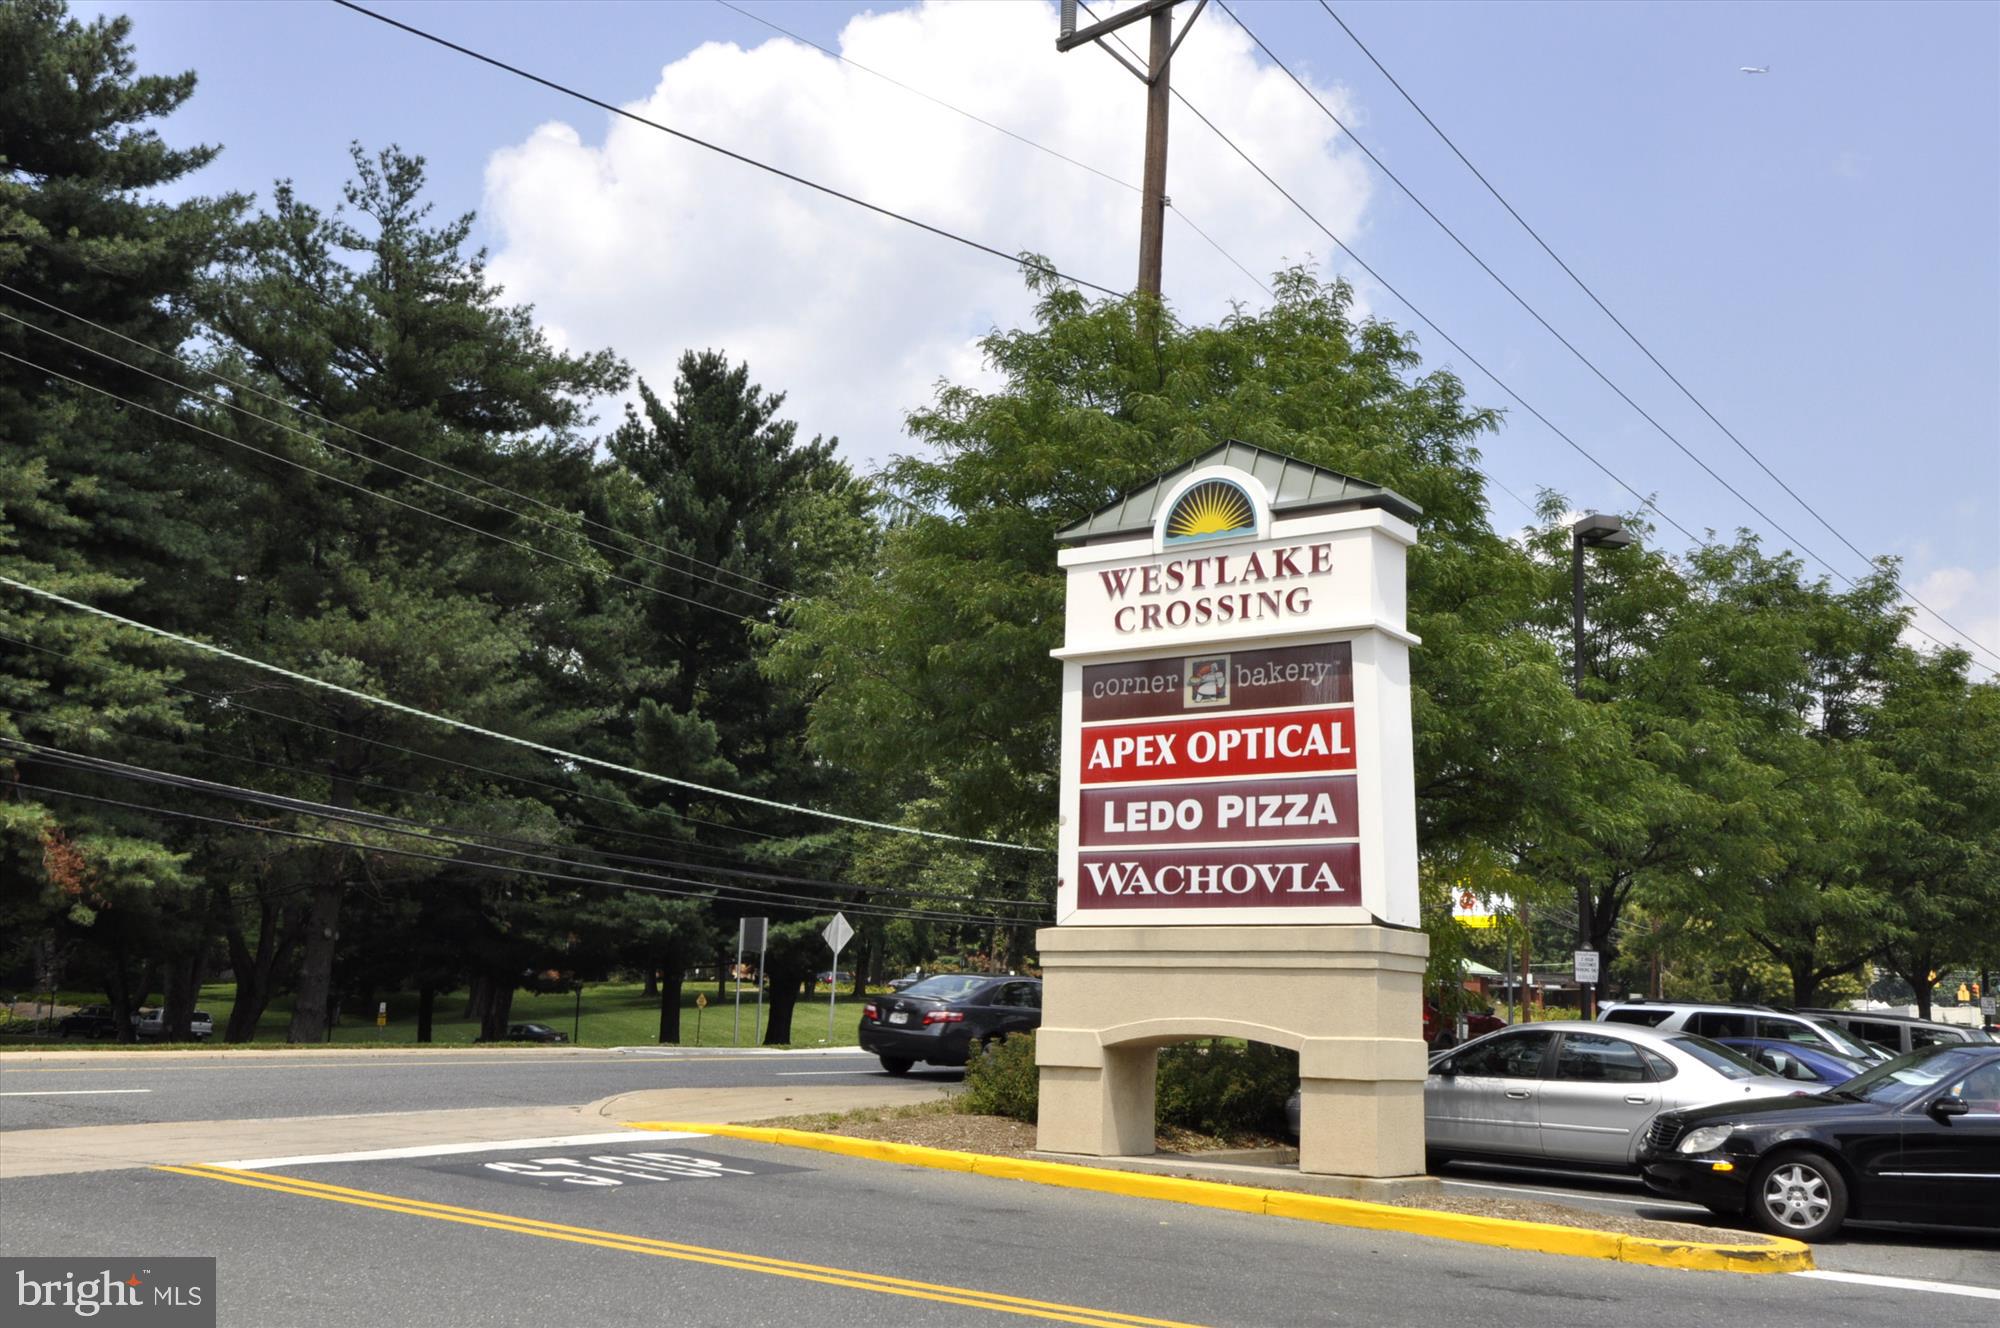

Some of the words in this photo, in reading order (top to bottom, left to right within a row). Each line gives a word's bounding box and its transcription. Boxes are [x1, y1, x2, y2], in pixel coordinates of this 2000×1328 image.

[1099, 543, 1334, 601] WESTLAKE
[1114, 587, 1313, 632] CROSSING
[1092, 671, 1179, 699] corner
[1235, 661, 1332, 688] bakery
[1087, 733, 1177, 770] APEX
[1186, 721, 1351, 764] OPTICAL
[1103, 799, 1204, 833] LEDO
[1217, 792, 1338, 829] PIZZA
[1083, 861, 1345, 897] WACHOVIA
[484, 1151, 756, 1187] STOP
